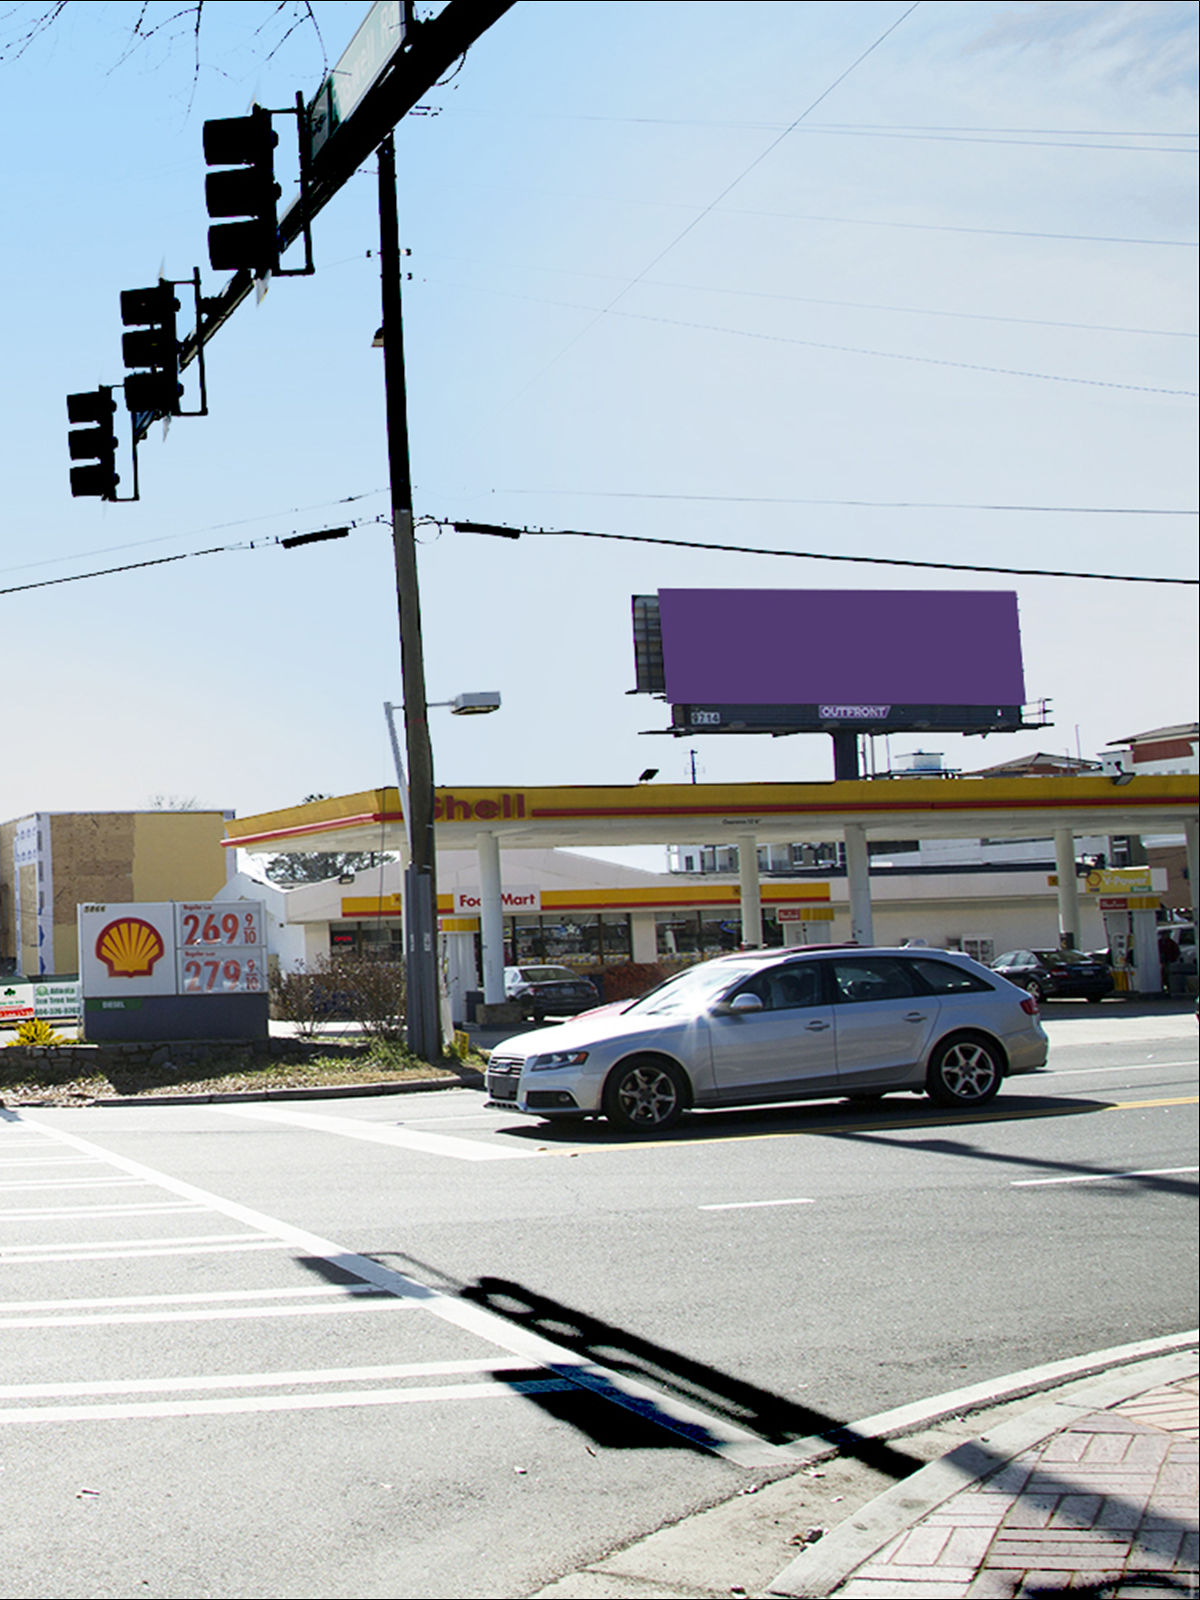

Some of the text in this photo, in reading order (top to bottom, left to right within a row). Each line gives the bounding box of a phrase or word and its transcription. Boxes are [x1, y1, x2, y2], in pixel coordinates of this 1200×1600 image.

[821, 705, 888, 718] OUTFRONT
[434, 793, 525, 820] Shell
[1102, 876, 1147, 886] V-Power
[501, 893, 535, 906] Mart
[183, 913, 239, 945] 269
[185, 960, 241, 991] 279
[102, 1001, 126, 1009] DIESEL
